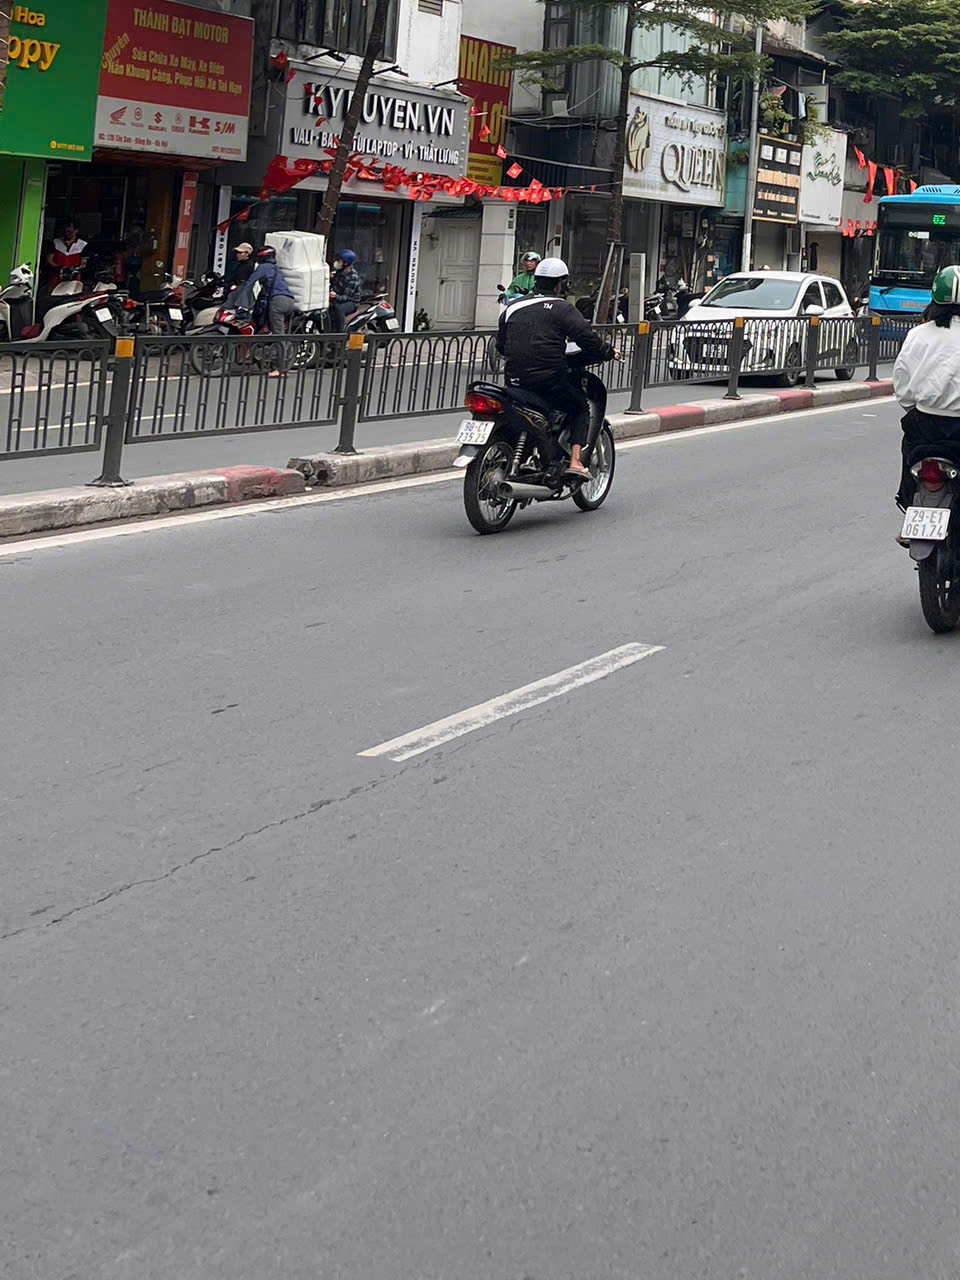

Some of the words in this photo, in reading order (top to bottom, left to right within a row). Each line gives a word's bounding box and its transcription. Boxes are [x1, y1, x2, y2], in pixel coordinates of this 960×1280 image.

[171, 15, 191, 39] ĐẠT
[194, 19, 229, 44] MOTOR
[8, 35, 60, 70] ppy
[293, 128, 313, 145] VALI
[367, 137, 398, 157] LAPTOP
[661, 143, 725, 192] QUEEN
